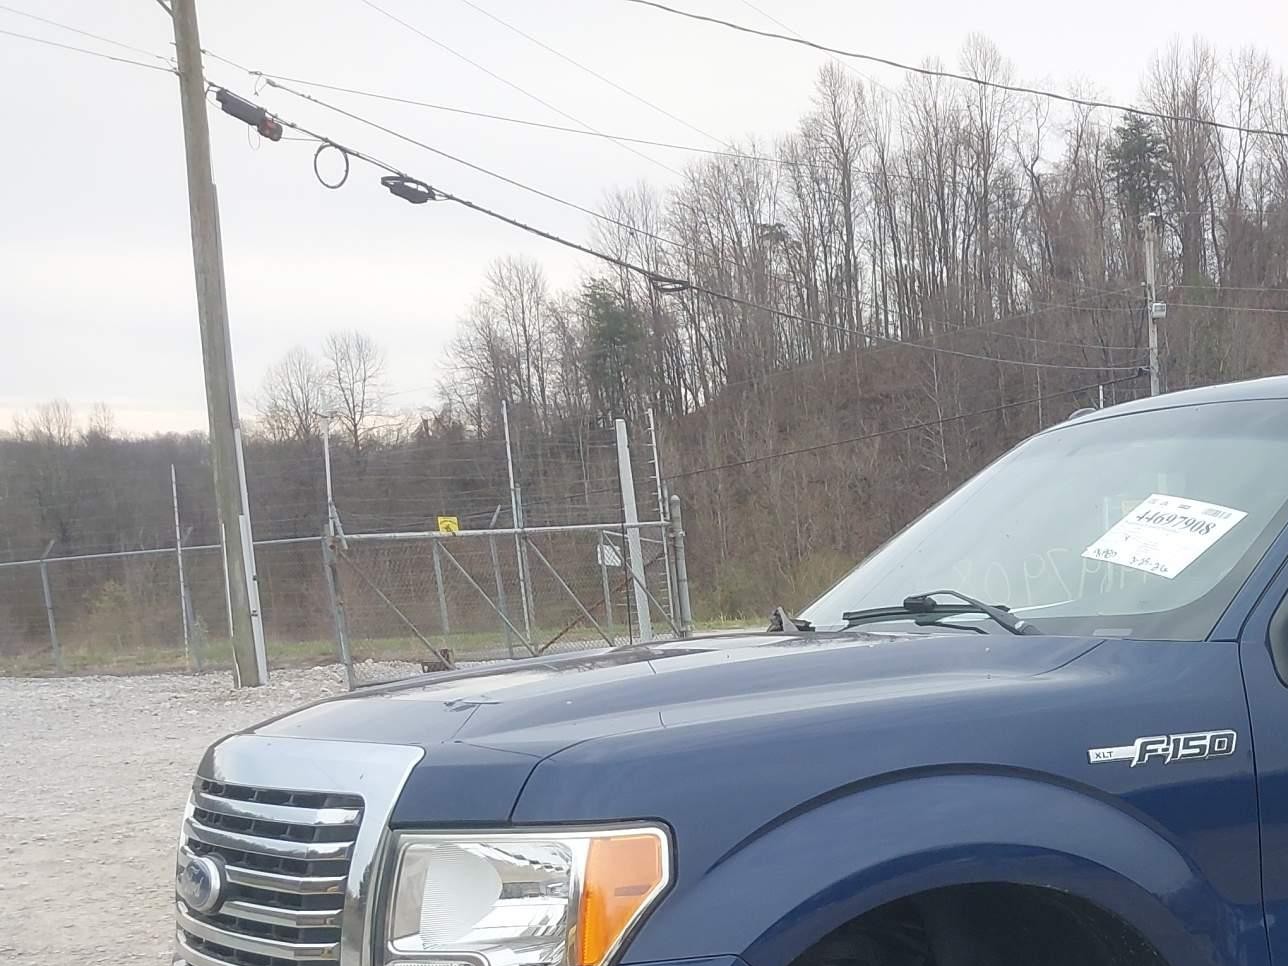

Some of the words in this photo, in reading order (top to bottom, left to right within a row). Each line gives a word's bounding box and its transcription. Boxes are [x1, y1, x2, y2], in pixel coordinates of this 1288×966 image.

[1136, 510, 1216, 535] 44697908
[1095, 750, 1114, 759] XLT
[1131, 730, 1237, 767] F-150
